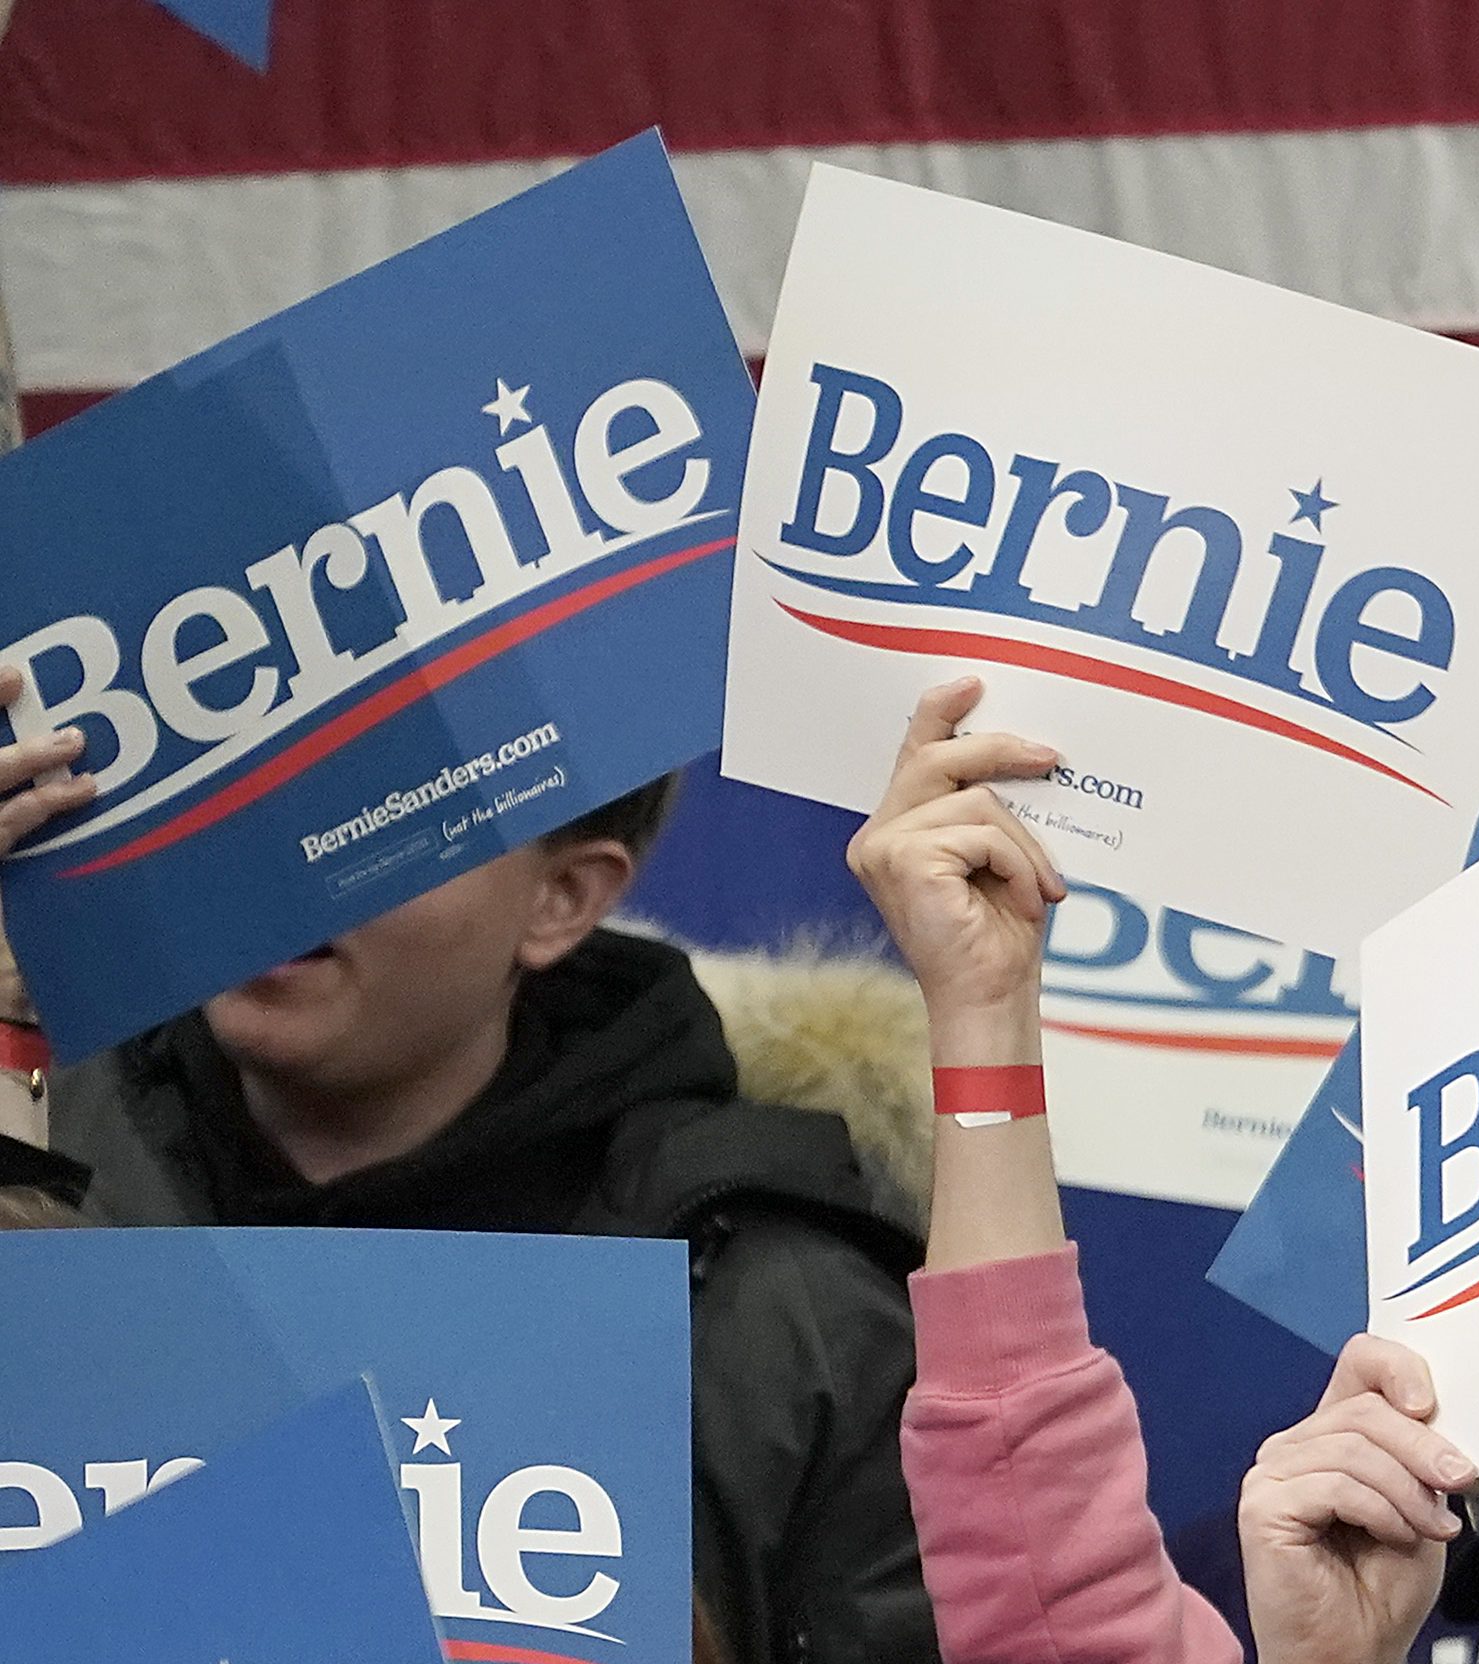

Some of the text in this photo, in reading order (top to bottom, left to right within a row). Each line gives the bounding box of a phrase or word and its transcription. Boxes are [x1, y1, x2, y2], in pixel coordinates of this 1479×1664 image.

[4, 378, 713, 798] Bernie
[780, 361, 1457, 726] Bernie
[300, 721, 561, 863] BernieSanders.com
[472, 807, 494, 826] the
